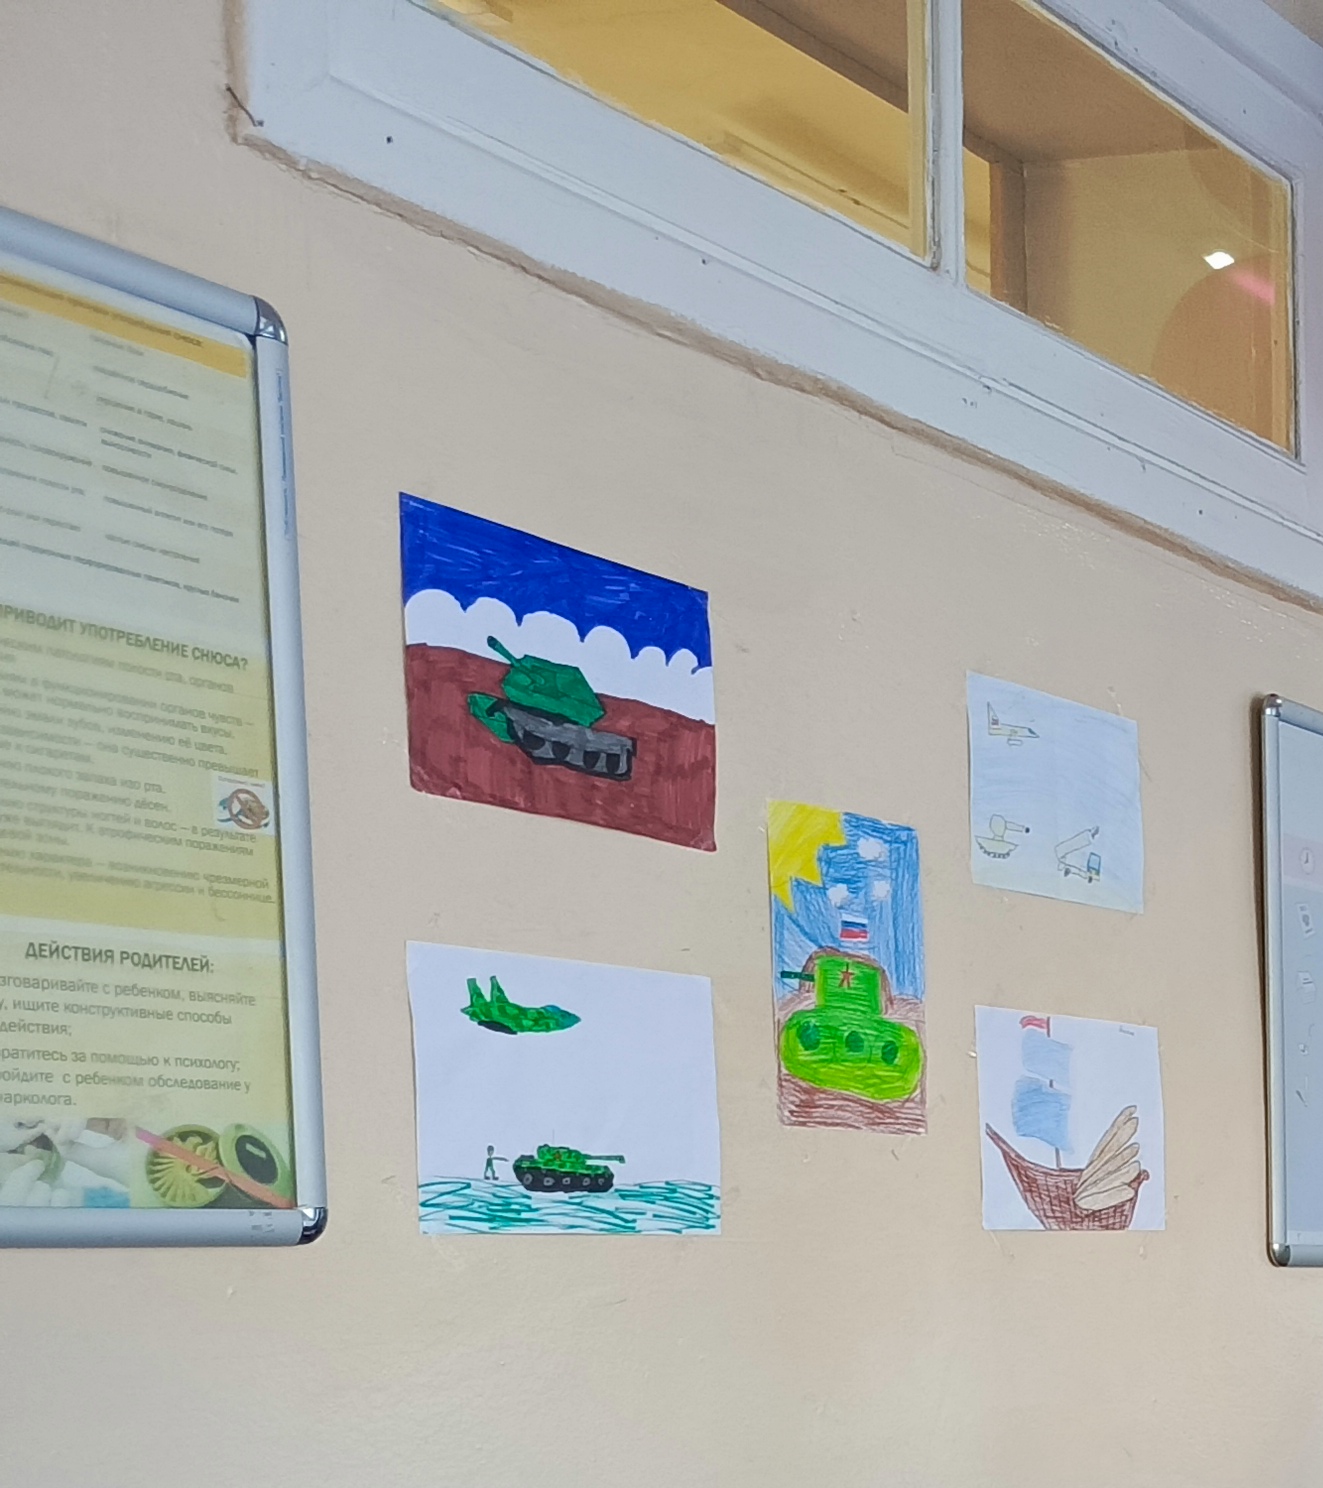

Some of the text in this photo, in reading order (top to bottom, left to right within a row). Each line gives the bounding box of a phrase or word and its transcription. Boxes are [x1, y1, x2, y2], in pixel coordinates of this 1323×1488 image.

[78, 622, 189, 657] УПОТРЕБЛЕНИЕ
[190, 647, 248, 669] СНЮСА?
[24, 939, 215, 973] ДЕЙСТВИЯ РОДИТЕЛЕЙ:
[101, 983, 109, 995] с
[113, 983, 185, 1001] ребенком,
[188, 989, 257, 1006] выясняйте
[12, 999, 59, 1013] ищите
[63, 1002, 174, 1022] конструктивные
[176, 1009, 232, 1024] способы
[0, 1046, 241, 1072] ратитесь за помощью к психологу;
[0, 1068, 251, 1093] ойдите с ребенком обследование у
[0, 1092, 77, 1107] арколога.
